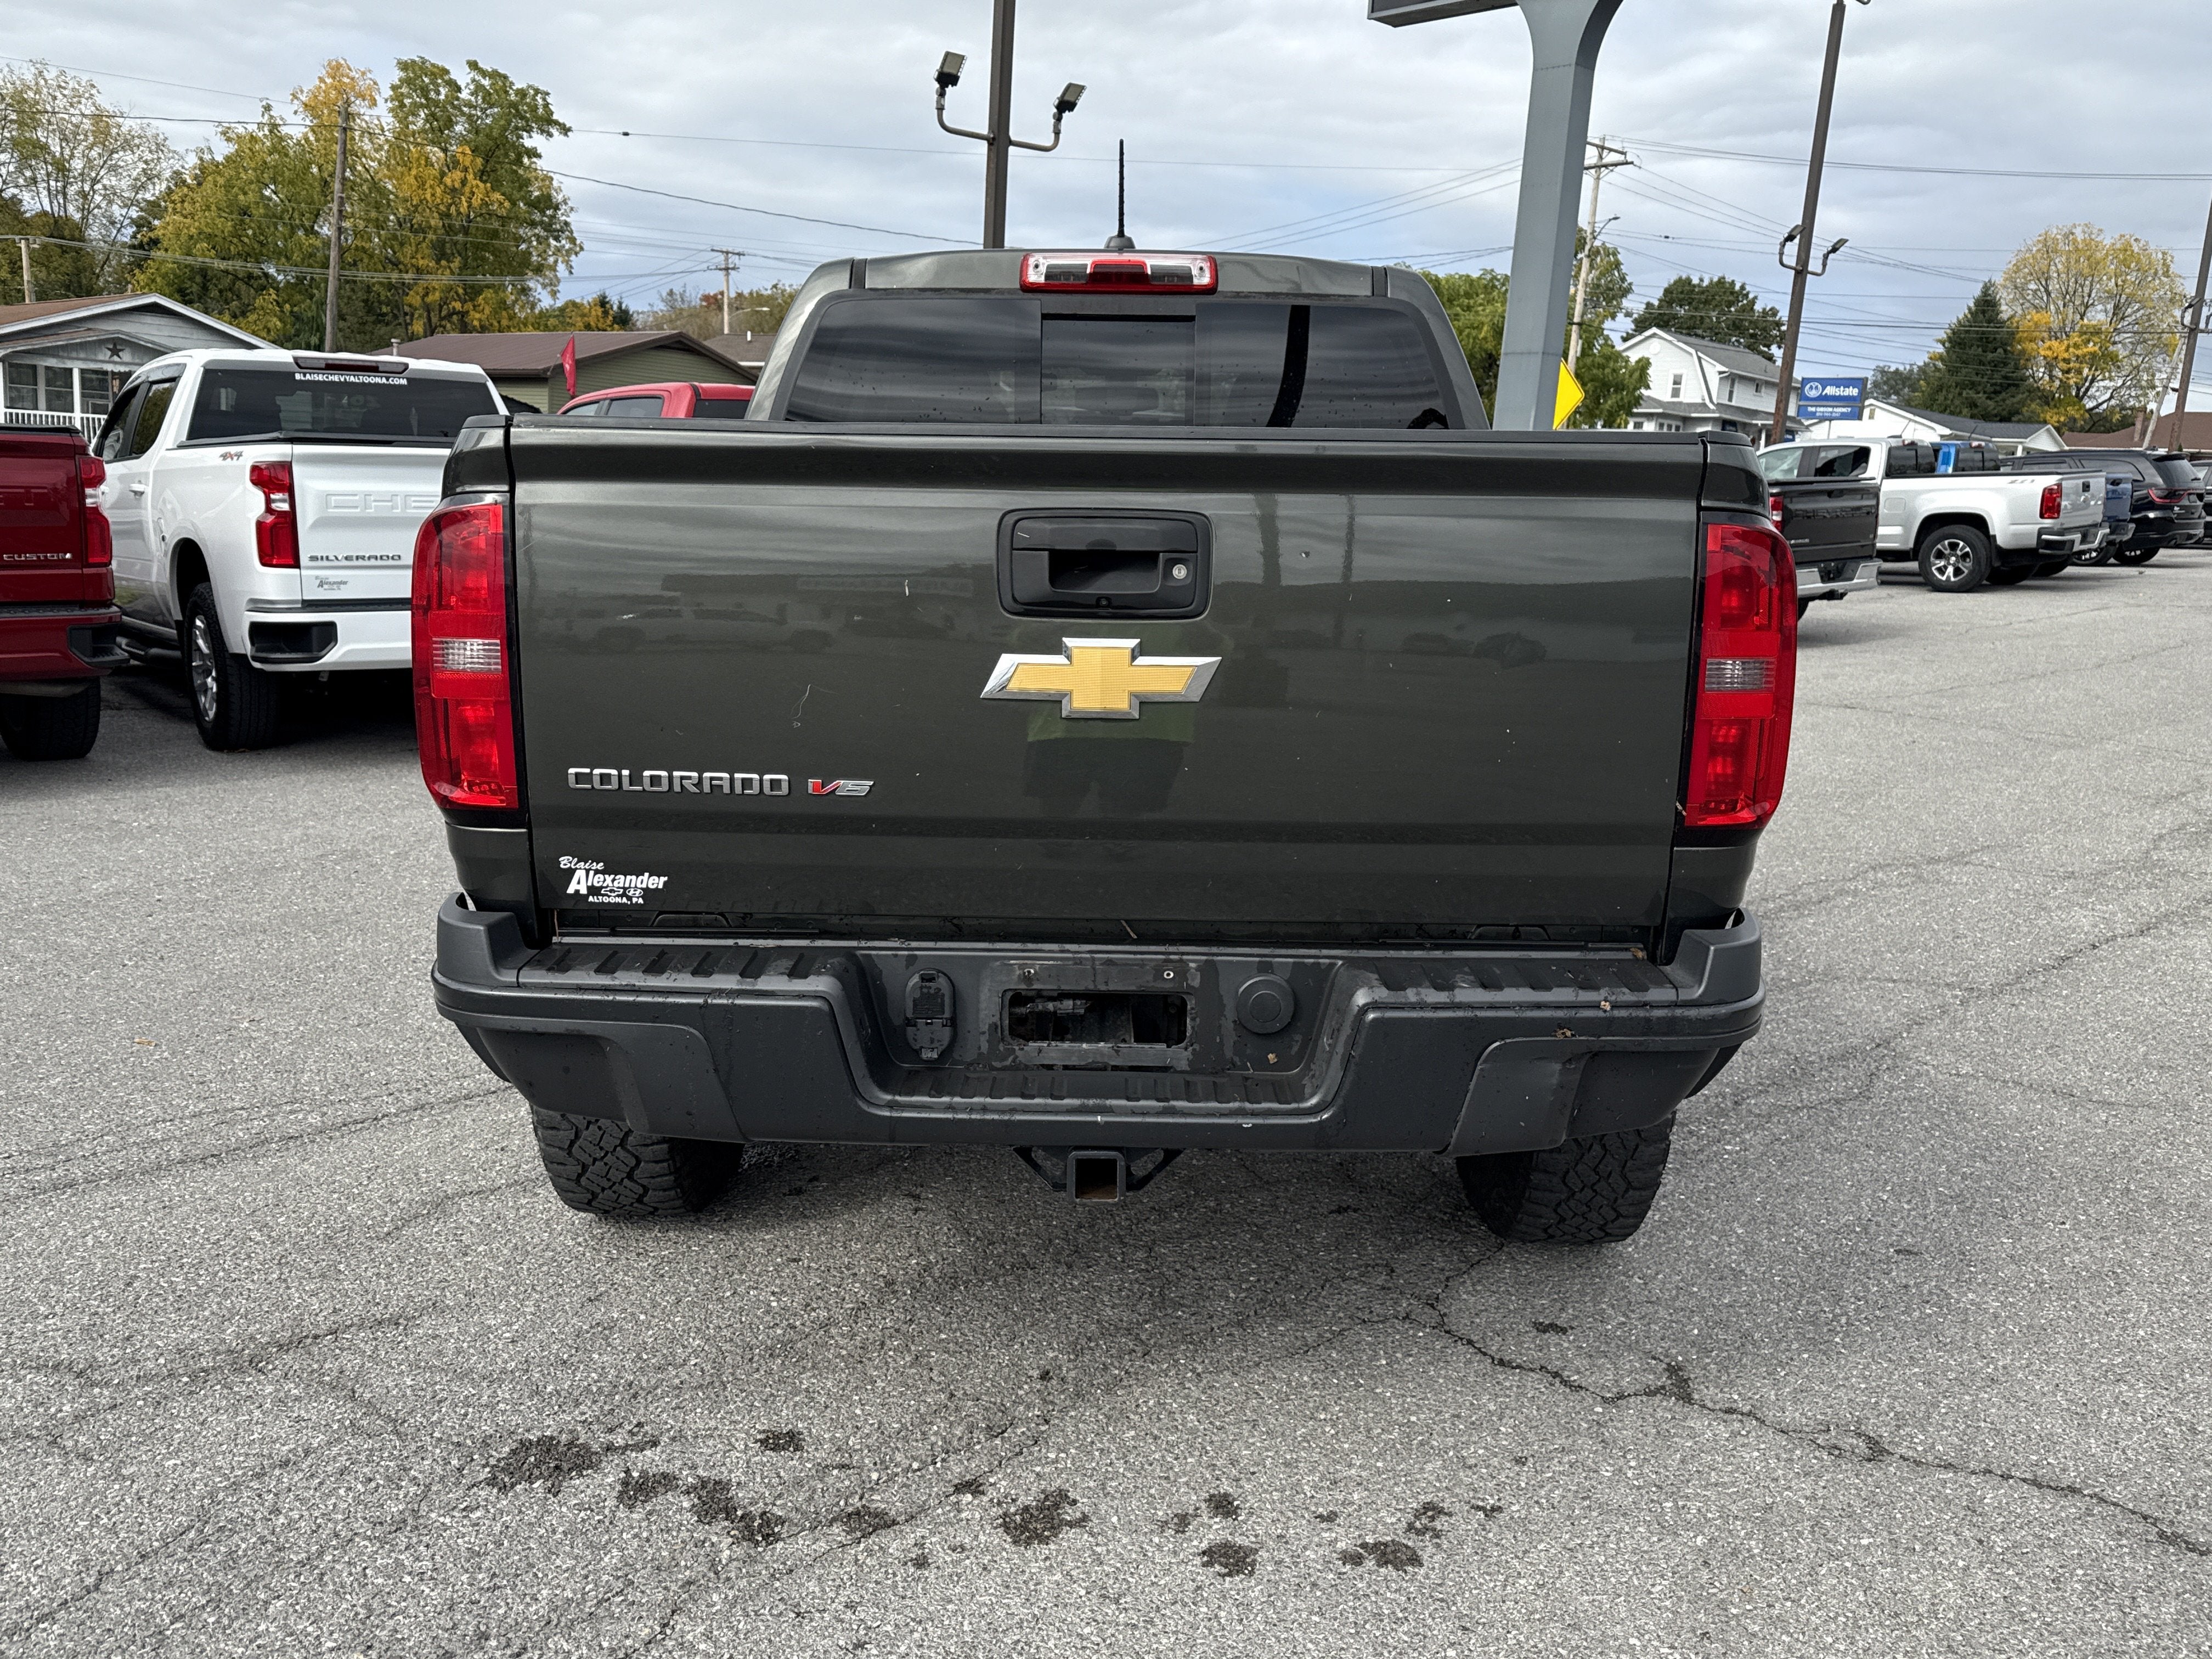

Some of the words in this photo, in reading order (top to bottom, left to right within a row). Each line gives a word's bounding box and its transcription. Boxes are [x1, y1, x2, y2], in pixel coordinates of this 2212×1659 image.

[295, 373, 408, 385] BLAISECHEVYALTOONA.COM
[1822, 386, 1859, 396] Allstate
[317, 579, 348, 588] Alexander
[568, 768, 789, 795] COLORADO
[808, 778, 874, 795] V6
[558, 856, 605, 870] Blaise
[566, 869, 668, 894] Alexander
[588, 895, 630, 905] ALTOONA,
